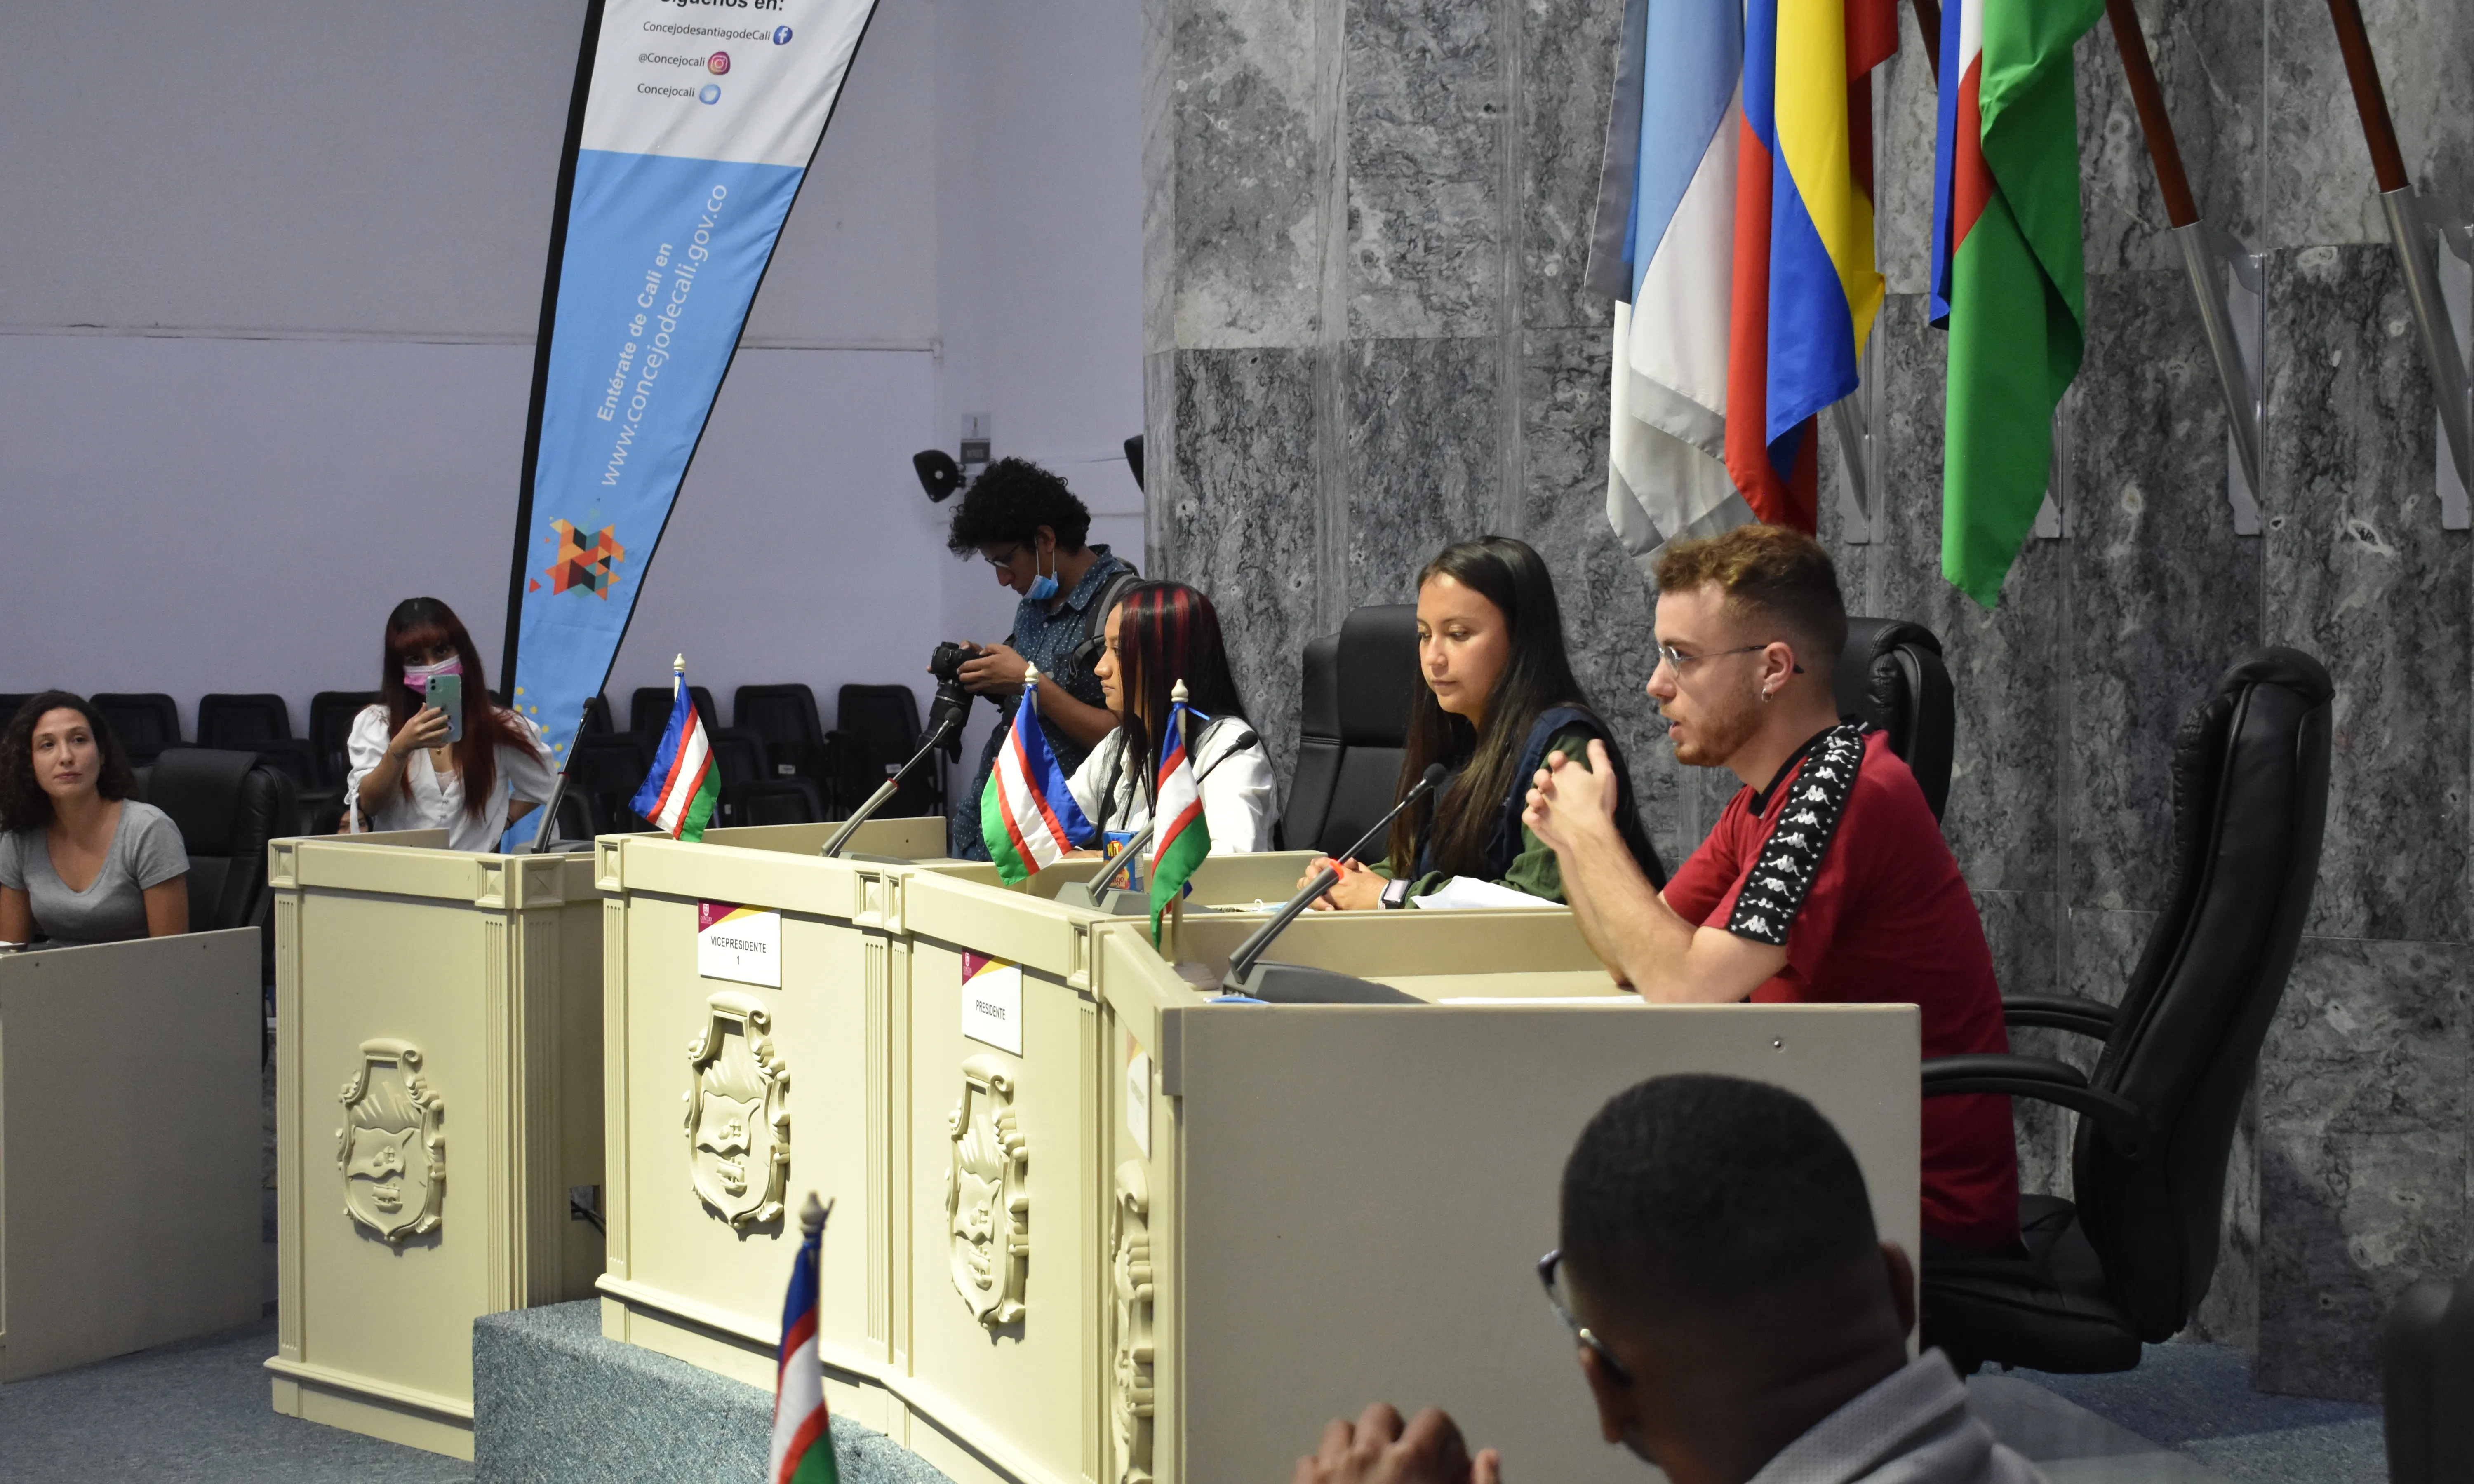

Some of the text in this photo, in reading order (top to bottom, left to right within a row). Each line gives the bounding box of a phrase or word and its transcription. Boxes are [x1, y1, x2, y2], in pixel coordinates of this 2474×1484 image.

[755, 0, 783, 11] en:
[643, 21, 771, 40] ConcejodesantiagodeCali
[638, 52, 706, 68] @Concejocali
[637, 83, 695, 98] Concejocali
[597, 243, 673, 422] Entérate de Cali en
[602, 184, 727, 486] www.concejodecali.gov.co
[710, 936, 767, 953] VICEPRESIDENTE
[737, 955, 739, 965] 1
[976, 1000, 1005, 1020] PRESIDENTE
